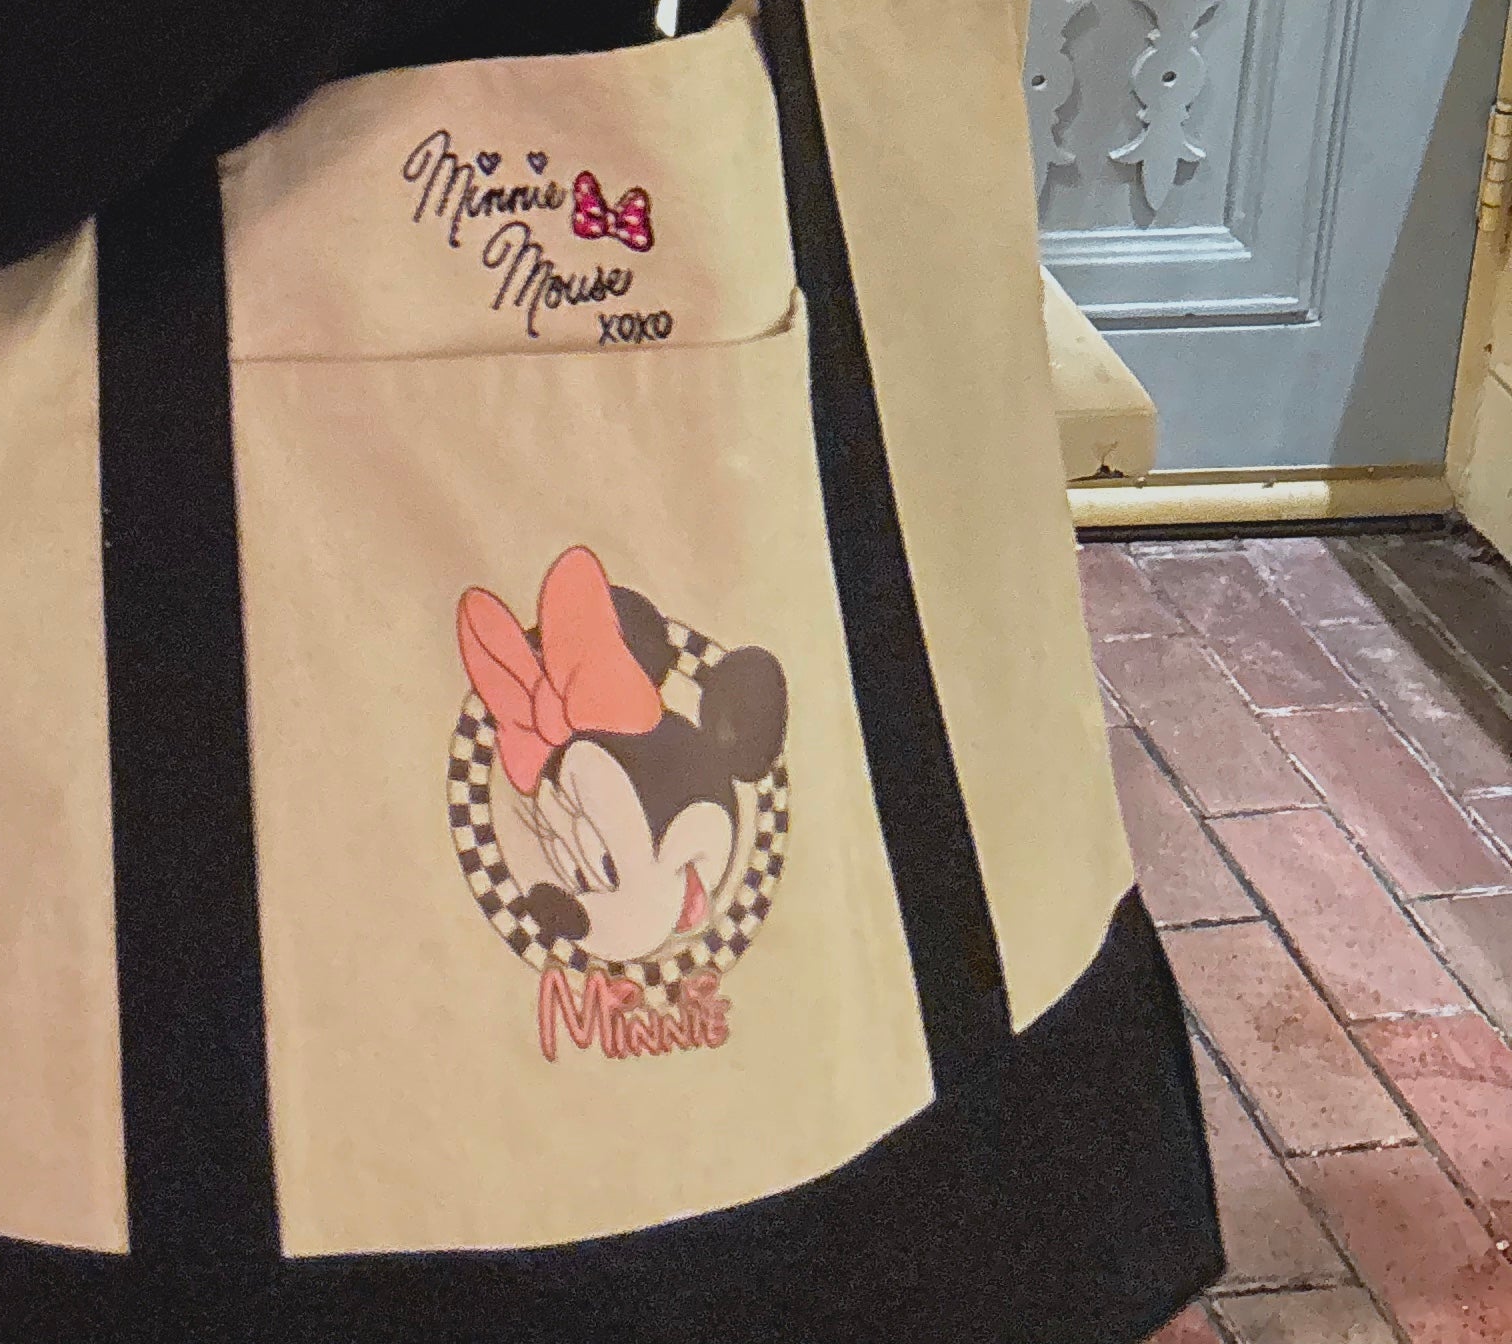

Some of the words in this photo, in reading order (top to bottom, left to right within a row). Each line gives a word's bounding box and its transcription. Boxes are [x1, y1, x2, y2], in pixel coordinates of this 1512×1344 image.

[403, 129, 565, 249] Minnie
[482, 220, 634, 339] Mouse
[598, 309, 674, 346] xoxo
